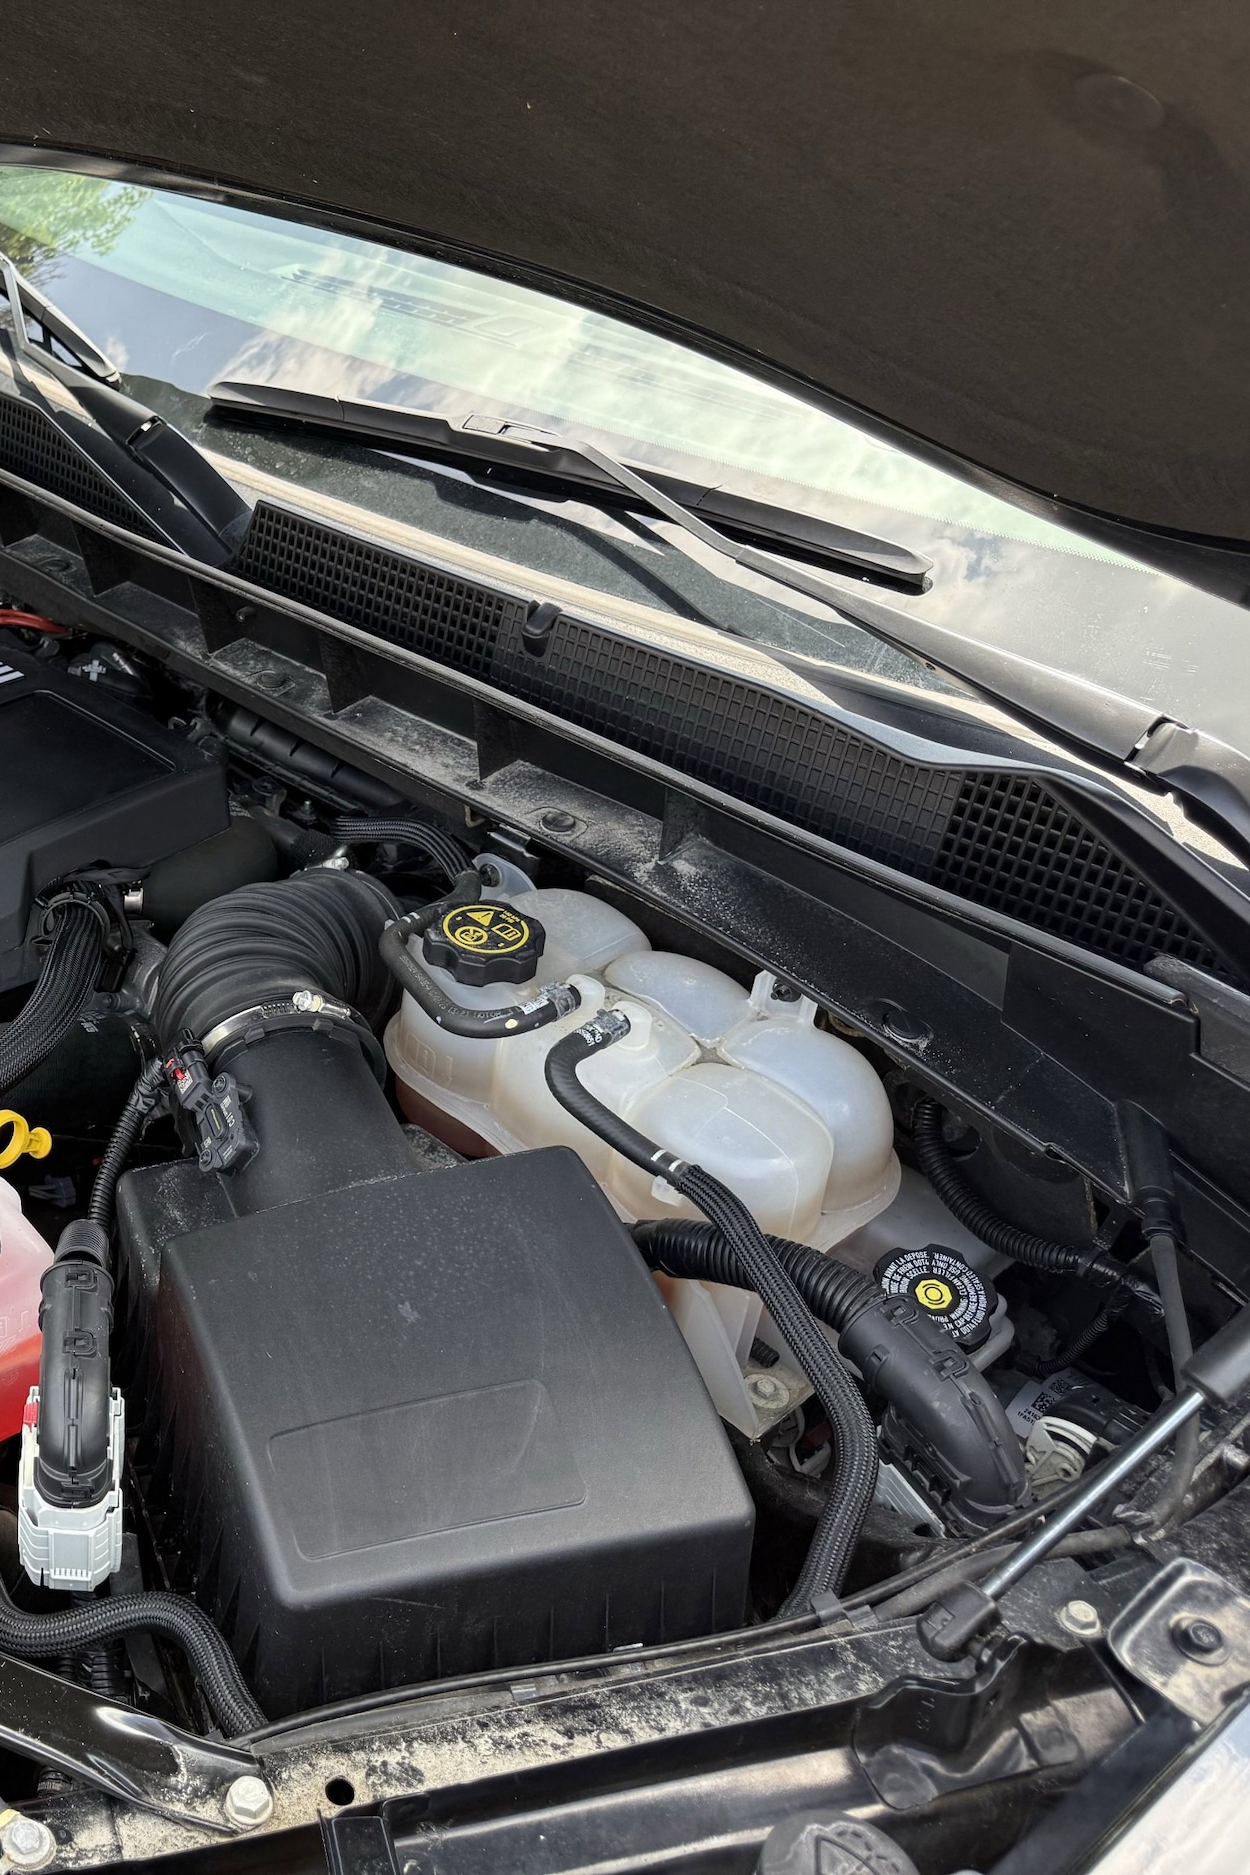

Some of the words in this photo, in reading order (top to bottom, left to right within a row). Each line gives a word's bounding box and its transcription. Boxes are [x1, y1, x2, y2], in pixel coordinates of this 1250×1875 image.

[895, 1256, 906, 1265] LA
[930, 1258, 948, 1269] ONLY
[932, 1266, 955, 1281] FILLER
[947, 1265, 961, 1276] USE
[951, 1277, 967, 1295] CLEAN
[965, 1269, 984, 1290] SEALED
[978, 1294, 986, 1311] FROM
[962, 1301, 978, 1321] BEFORE
[953, 1316, 967, 1328] CAP
